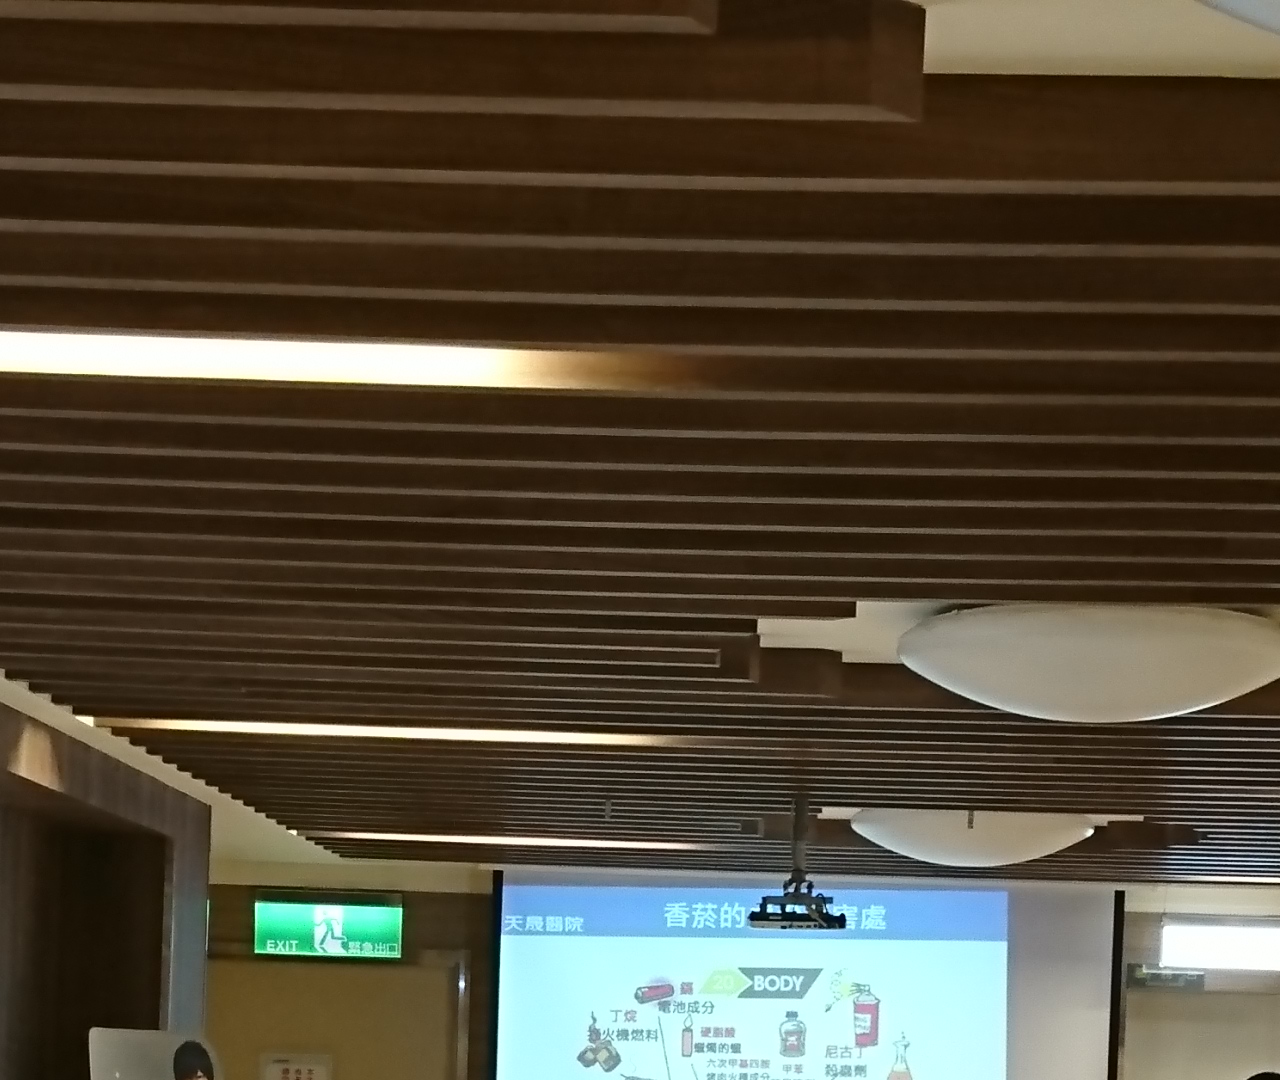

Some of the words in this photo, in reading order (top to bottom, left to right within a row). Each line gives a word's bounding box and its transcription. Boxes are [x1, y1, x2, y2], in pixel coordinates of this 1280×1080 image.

[664, 902, 886, 930] 香菸的害處
[504, 915, 584, 933] 天晟醫院
[267, 940, 298, 952] EXIT
[348, 942, 397, 955] 緊急出口
[753, 974, 804, 991] BODY
[657, 1001, 715, 1015] 電池成分
[610, 1009, 638, 1023] 丁烷
[782, 1064, 804, 1075] 甲苯
[824, 1064, 867, 1078] 殺蟲劑
